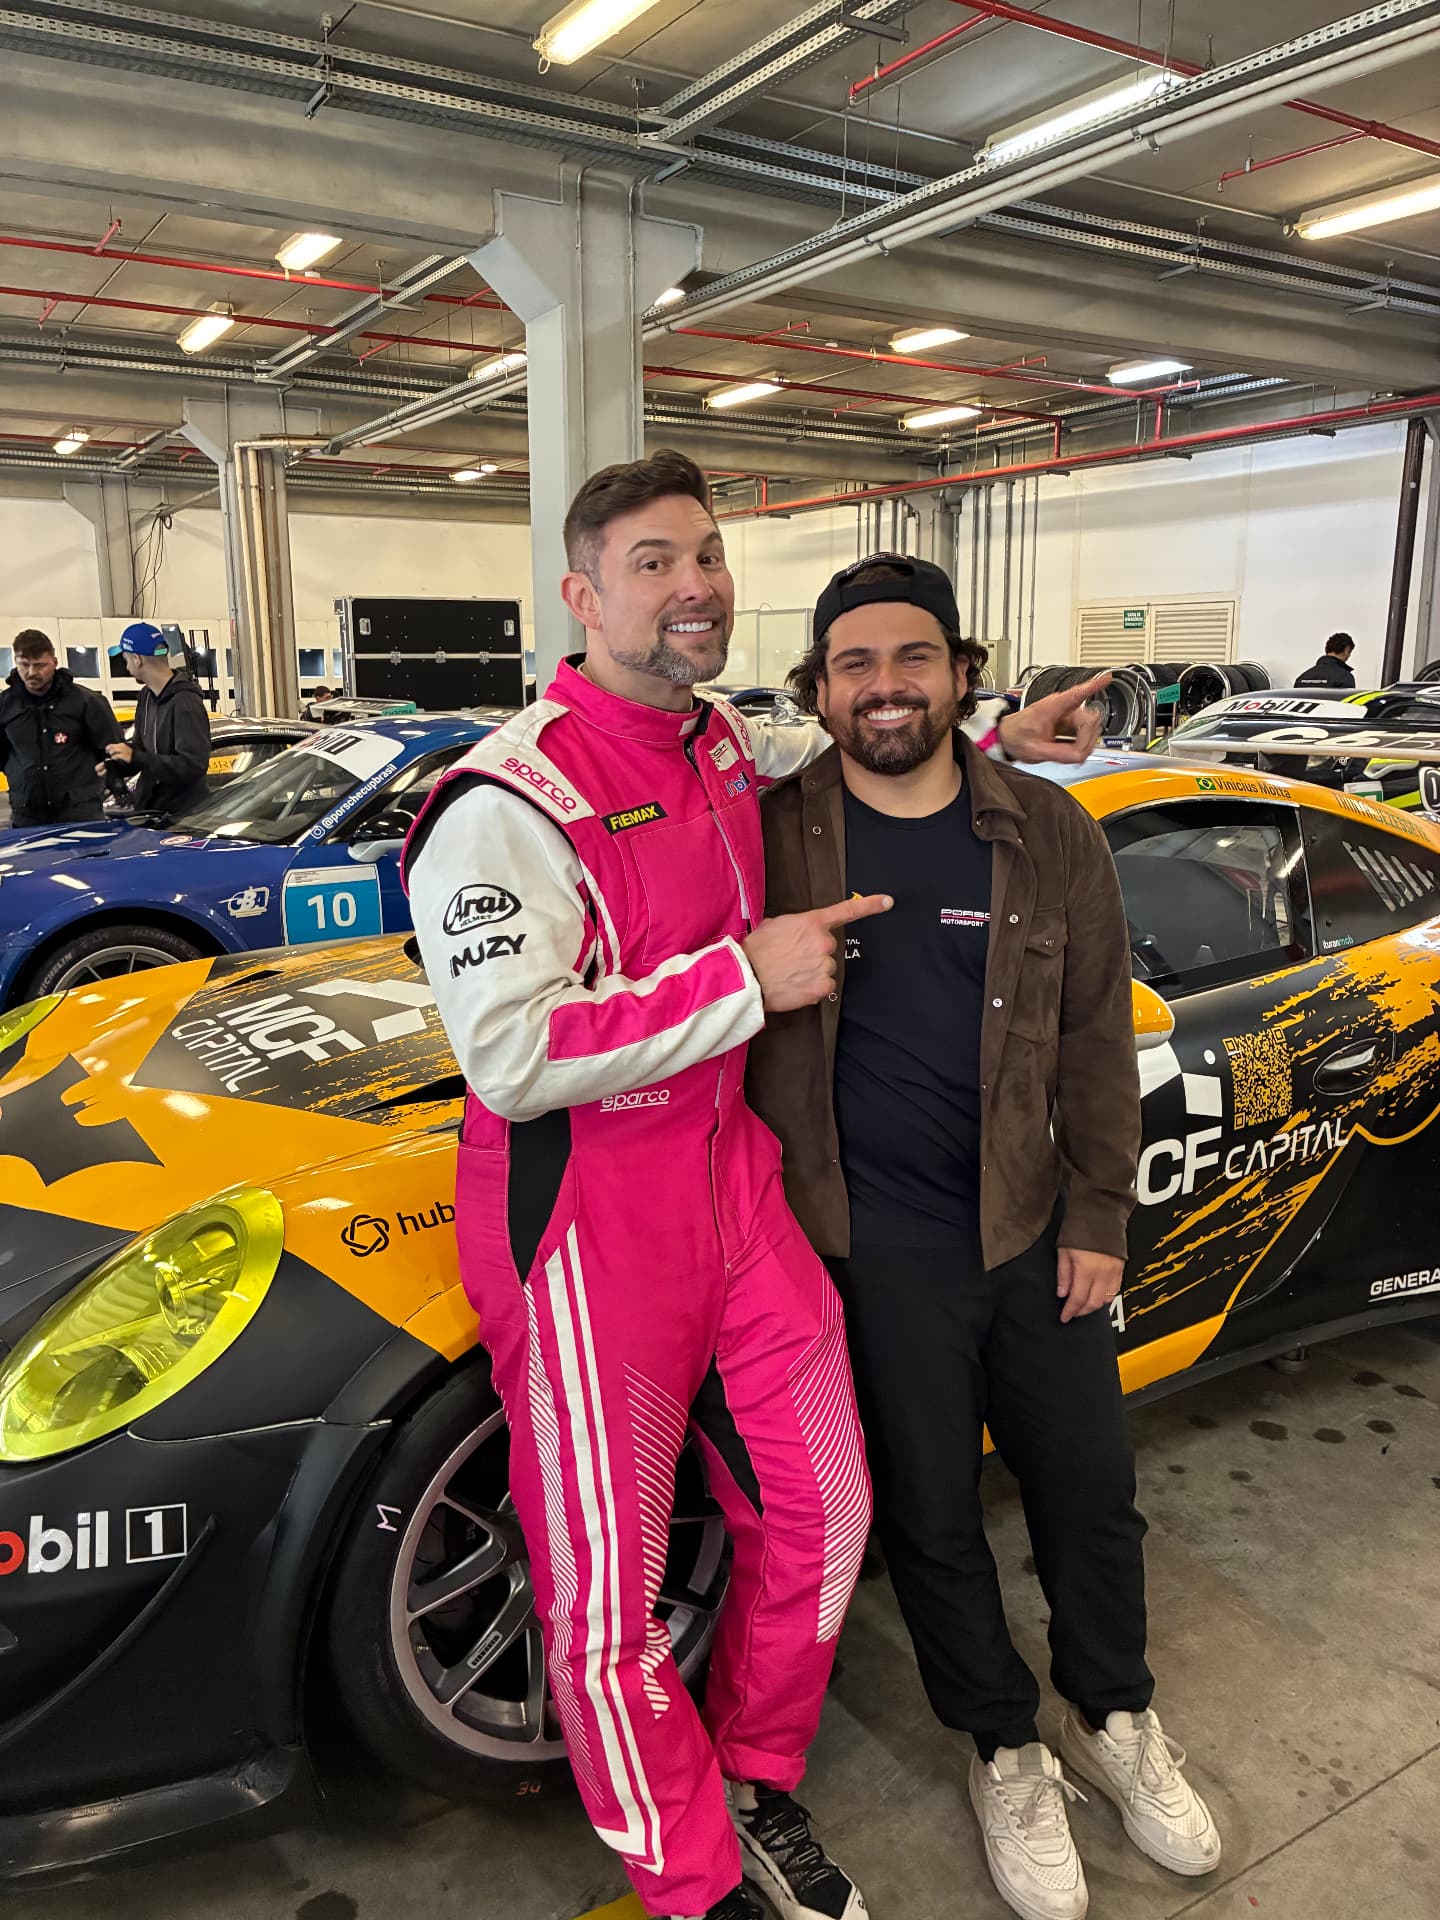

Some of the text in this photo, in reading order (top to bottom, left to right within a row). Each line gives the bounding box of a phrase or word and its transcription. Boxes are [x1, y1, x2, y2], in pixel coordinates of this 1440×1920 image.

[1224, 700, 1292, 716] Mobil
[321, 763, 398, 828] @porschecupbrasil
[500, 757, 577, 815] sparco
[1213, 777, 1259, 793] Vinicius
[307, 892, 357, 929] 10
[447, 891, 511, 931] Arai
[940, 918, 984, 928] MOTORSPORT
[449, 933, 528, 979] MUZY
[216, 993, 366, 1062] MCF
[171, 1018, 270, 1093] CAPITAL
[600, 1089, 670, 1112] sparco
[1225, 1118, 1350, 1181] CAPITAL
[1370, 1267, 1440, 1296] GENERA
[144, 1511, 163, 1554] 1
